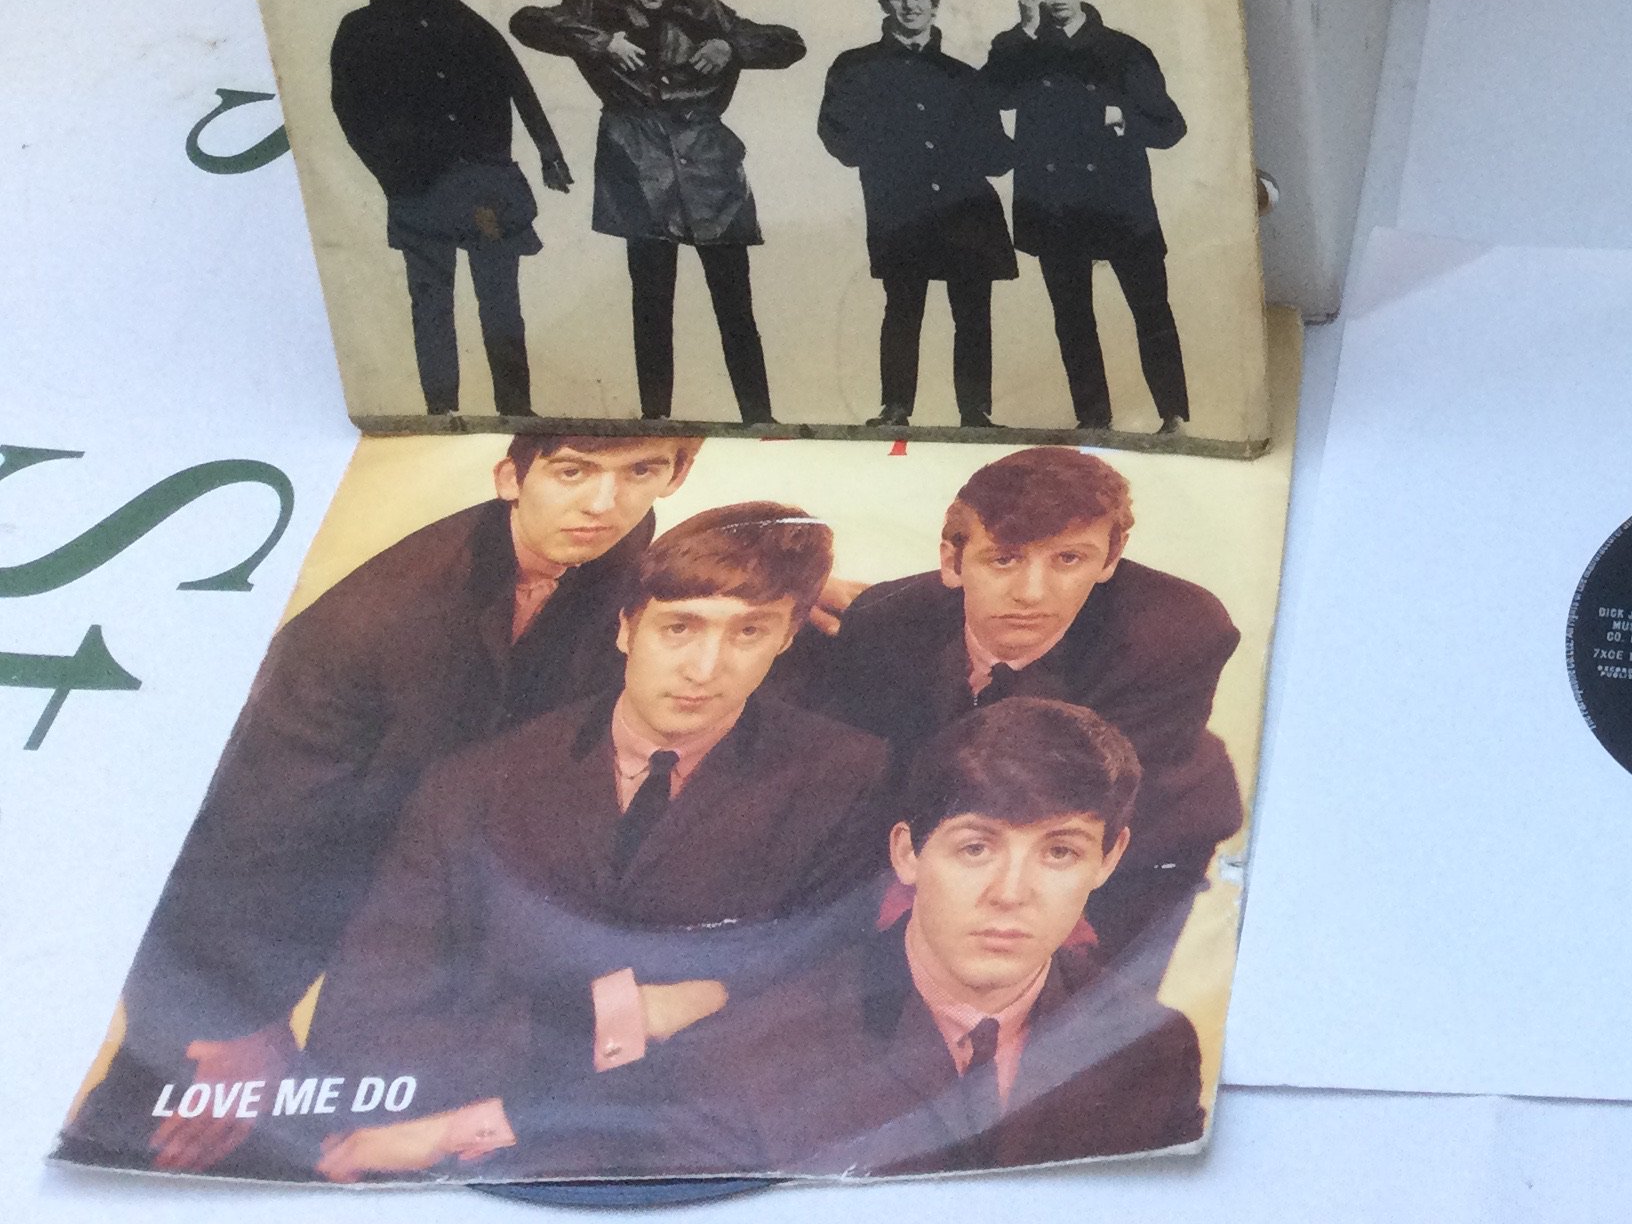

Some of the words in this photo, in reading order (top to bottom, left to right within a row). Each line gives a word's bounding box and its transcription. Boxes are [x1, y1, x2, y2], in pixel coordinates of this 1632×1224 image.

[1598, 607, 1625, 619] DICK
[1593, 648, 1625, 660] 7XCE
[152, 1080, 266, 1118] LOVE
[272, 1077, 345, 1116] ME
[351, 1076, 417, 1113] DO
